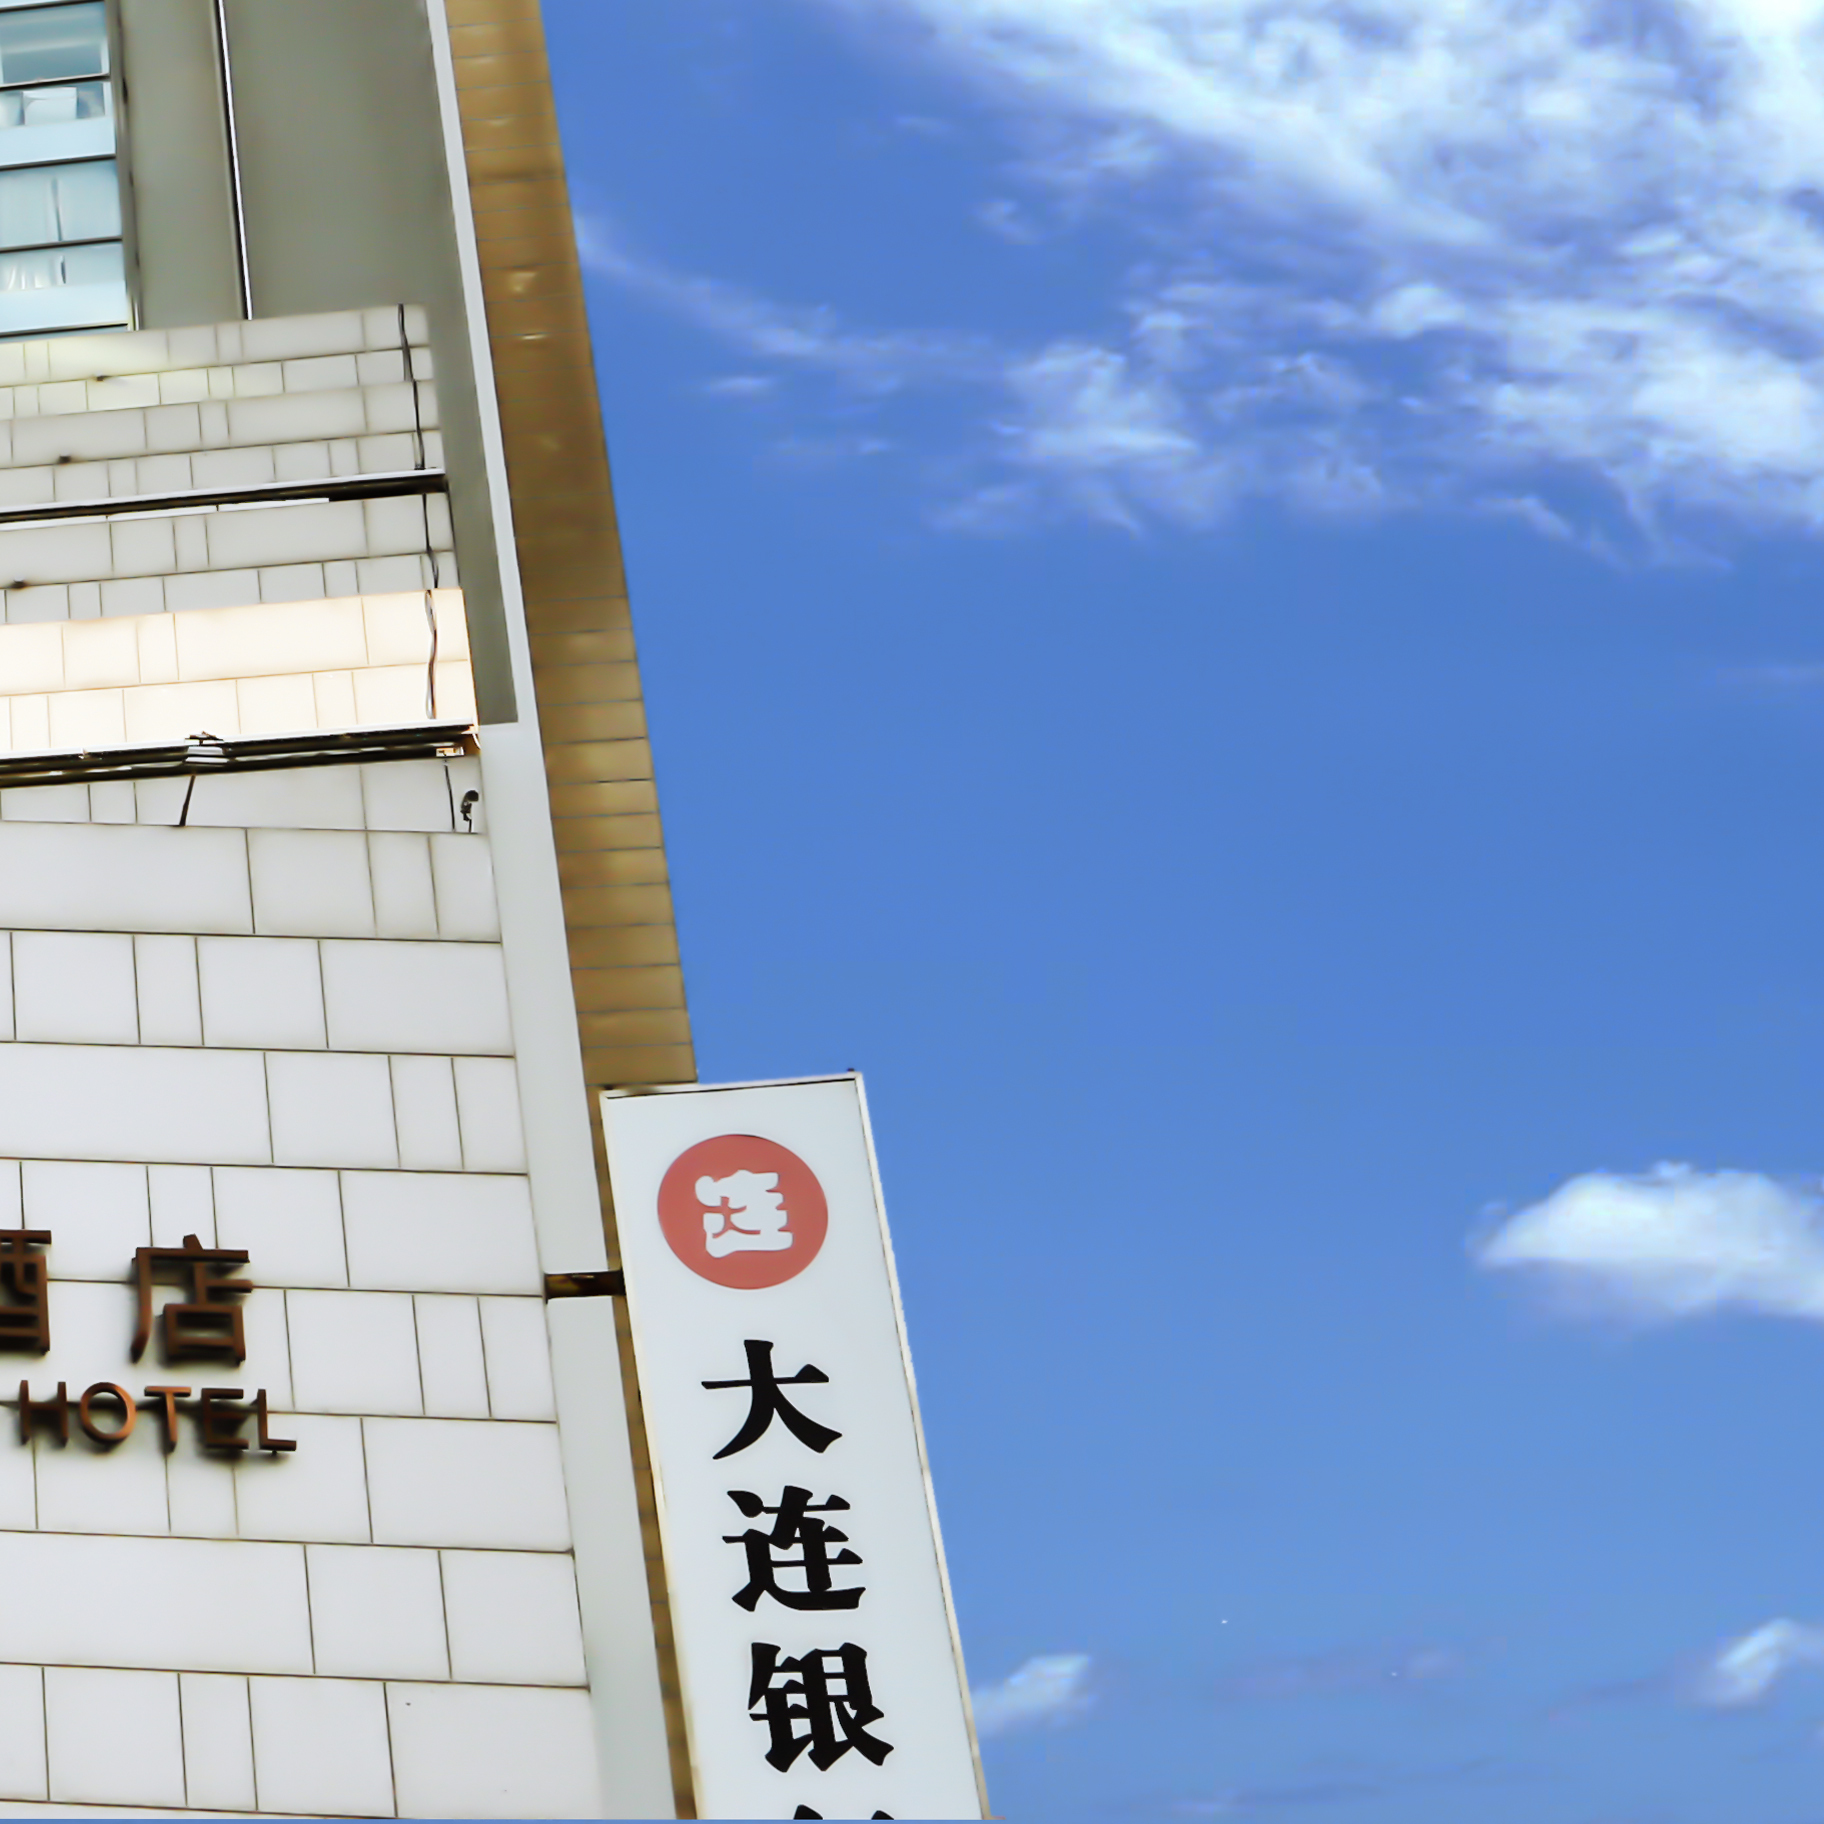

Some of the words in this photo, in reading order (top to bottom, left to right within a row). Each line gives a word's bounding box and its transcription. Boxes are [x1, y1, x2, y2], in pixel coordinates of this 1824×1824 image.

[19, 1379, 298, 1452] HOTEL
[700, 1339, 895, 1819] 大连银
